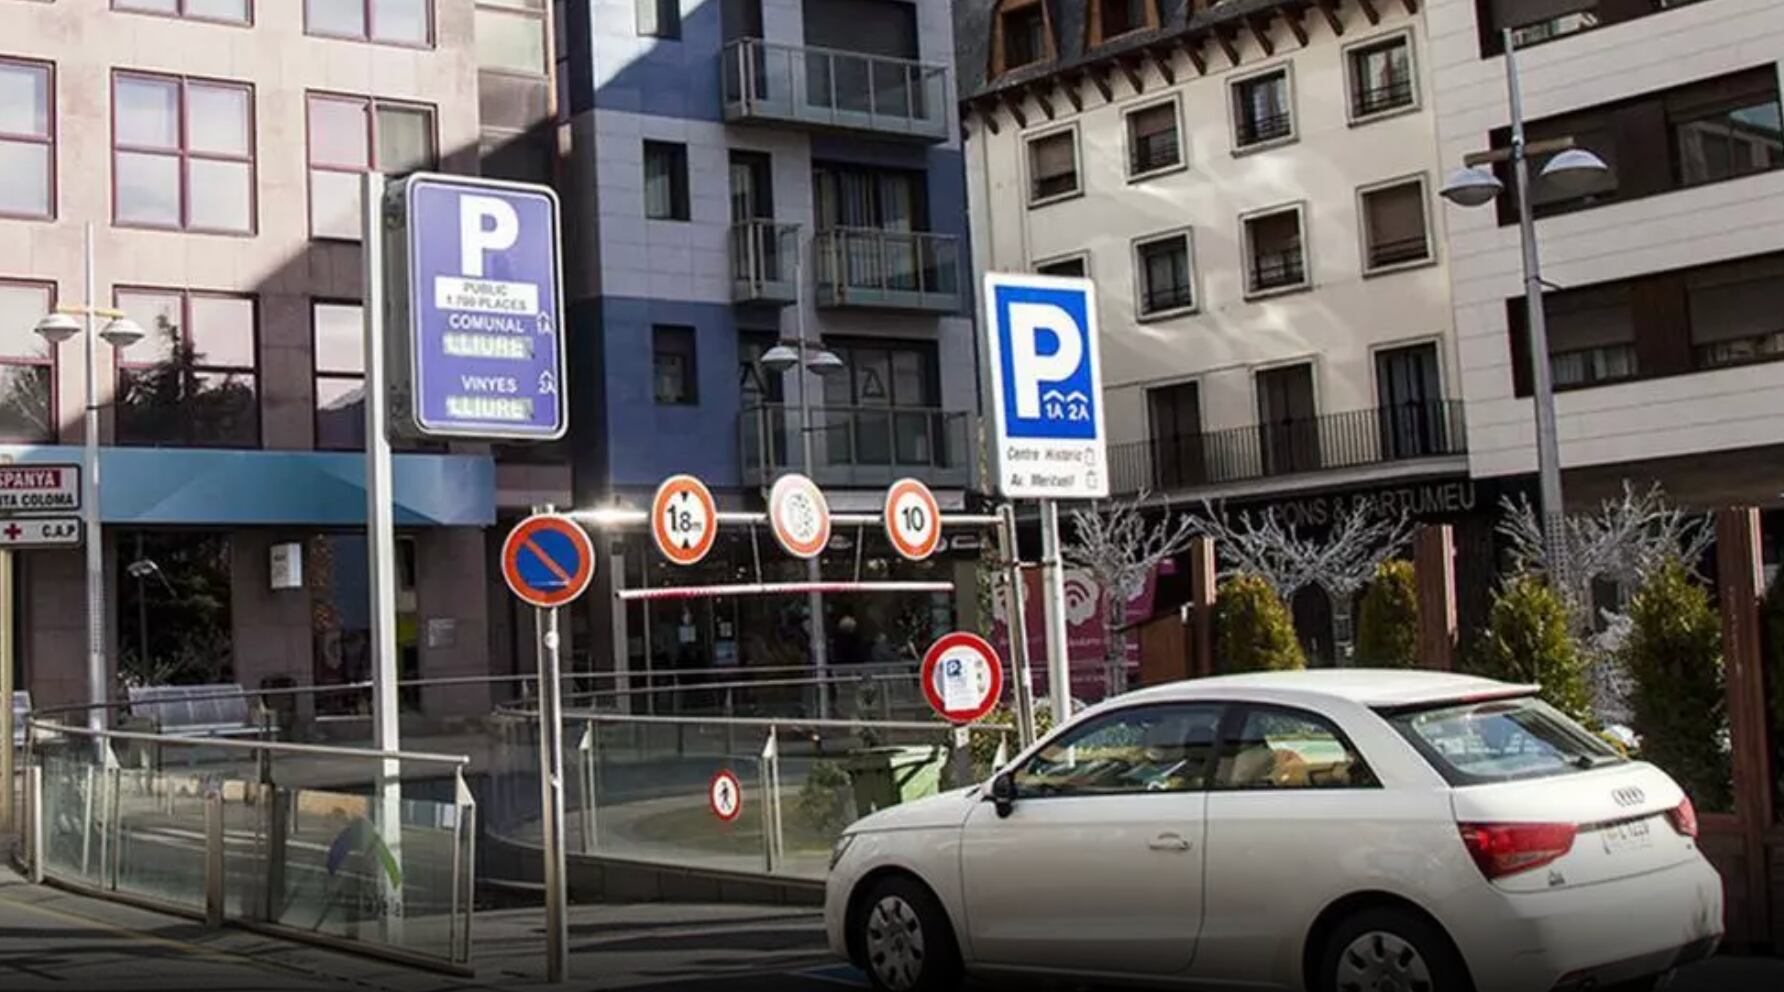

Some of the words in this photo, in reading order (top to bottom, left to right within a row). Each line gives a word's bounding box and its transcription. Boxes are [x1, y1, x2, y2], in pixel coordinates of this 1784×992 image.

[459, 193, 519, 276] P
[464, 282, 508, 296] PUBLIC
[478, 296, 527, 311] PLACES
[449, 314, 524, 333] COMUNAL
[1008, 303, 1082, 418] P
[461, 374, 517, 393] VINYES
[22, 493, 73, 505] COLOMA
[902, 507, 924, 532] 10
